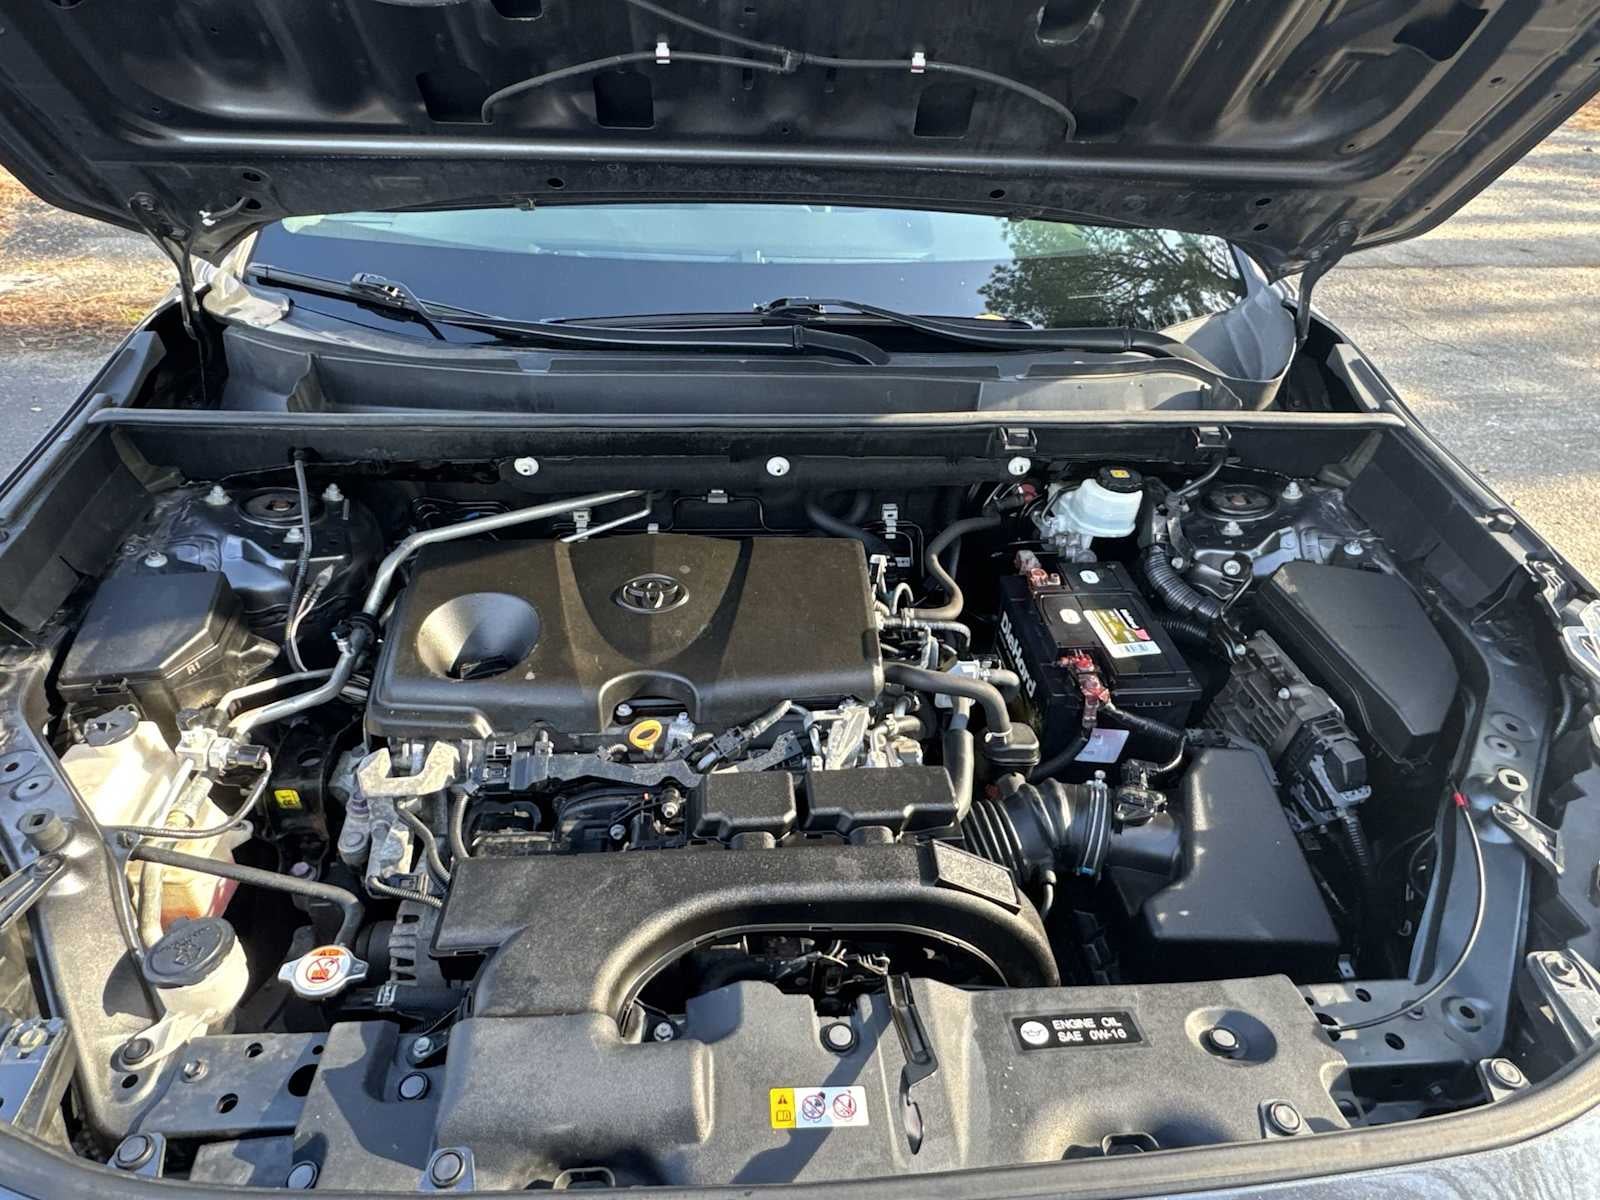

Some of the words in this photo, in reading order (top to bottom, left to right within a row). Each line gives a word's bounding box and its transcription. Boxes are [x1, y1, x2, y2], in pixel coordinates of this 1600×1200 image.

[1000, 610, 1036, 698] DieHard
[1052, 1018, 1096, 1030] ENGINE
[1101, 1017, 1122, 1028] OIL
[1057, 1031, 1083, 1042] SAE
